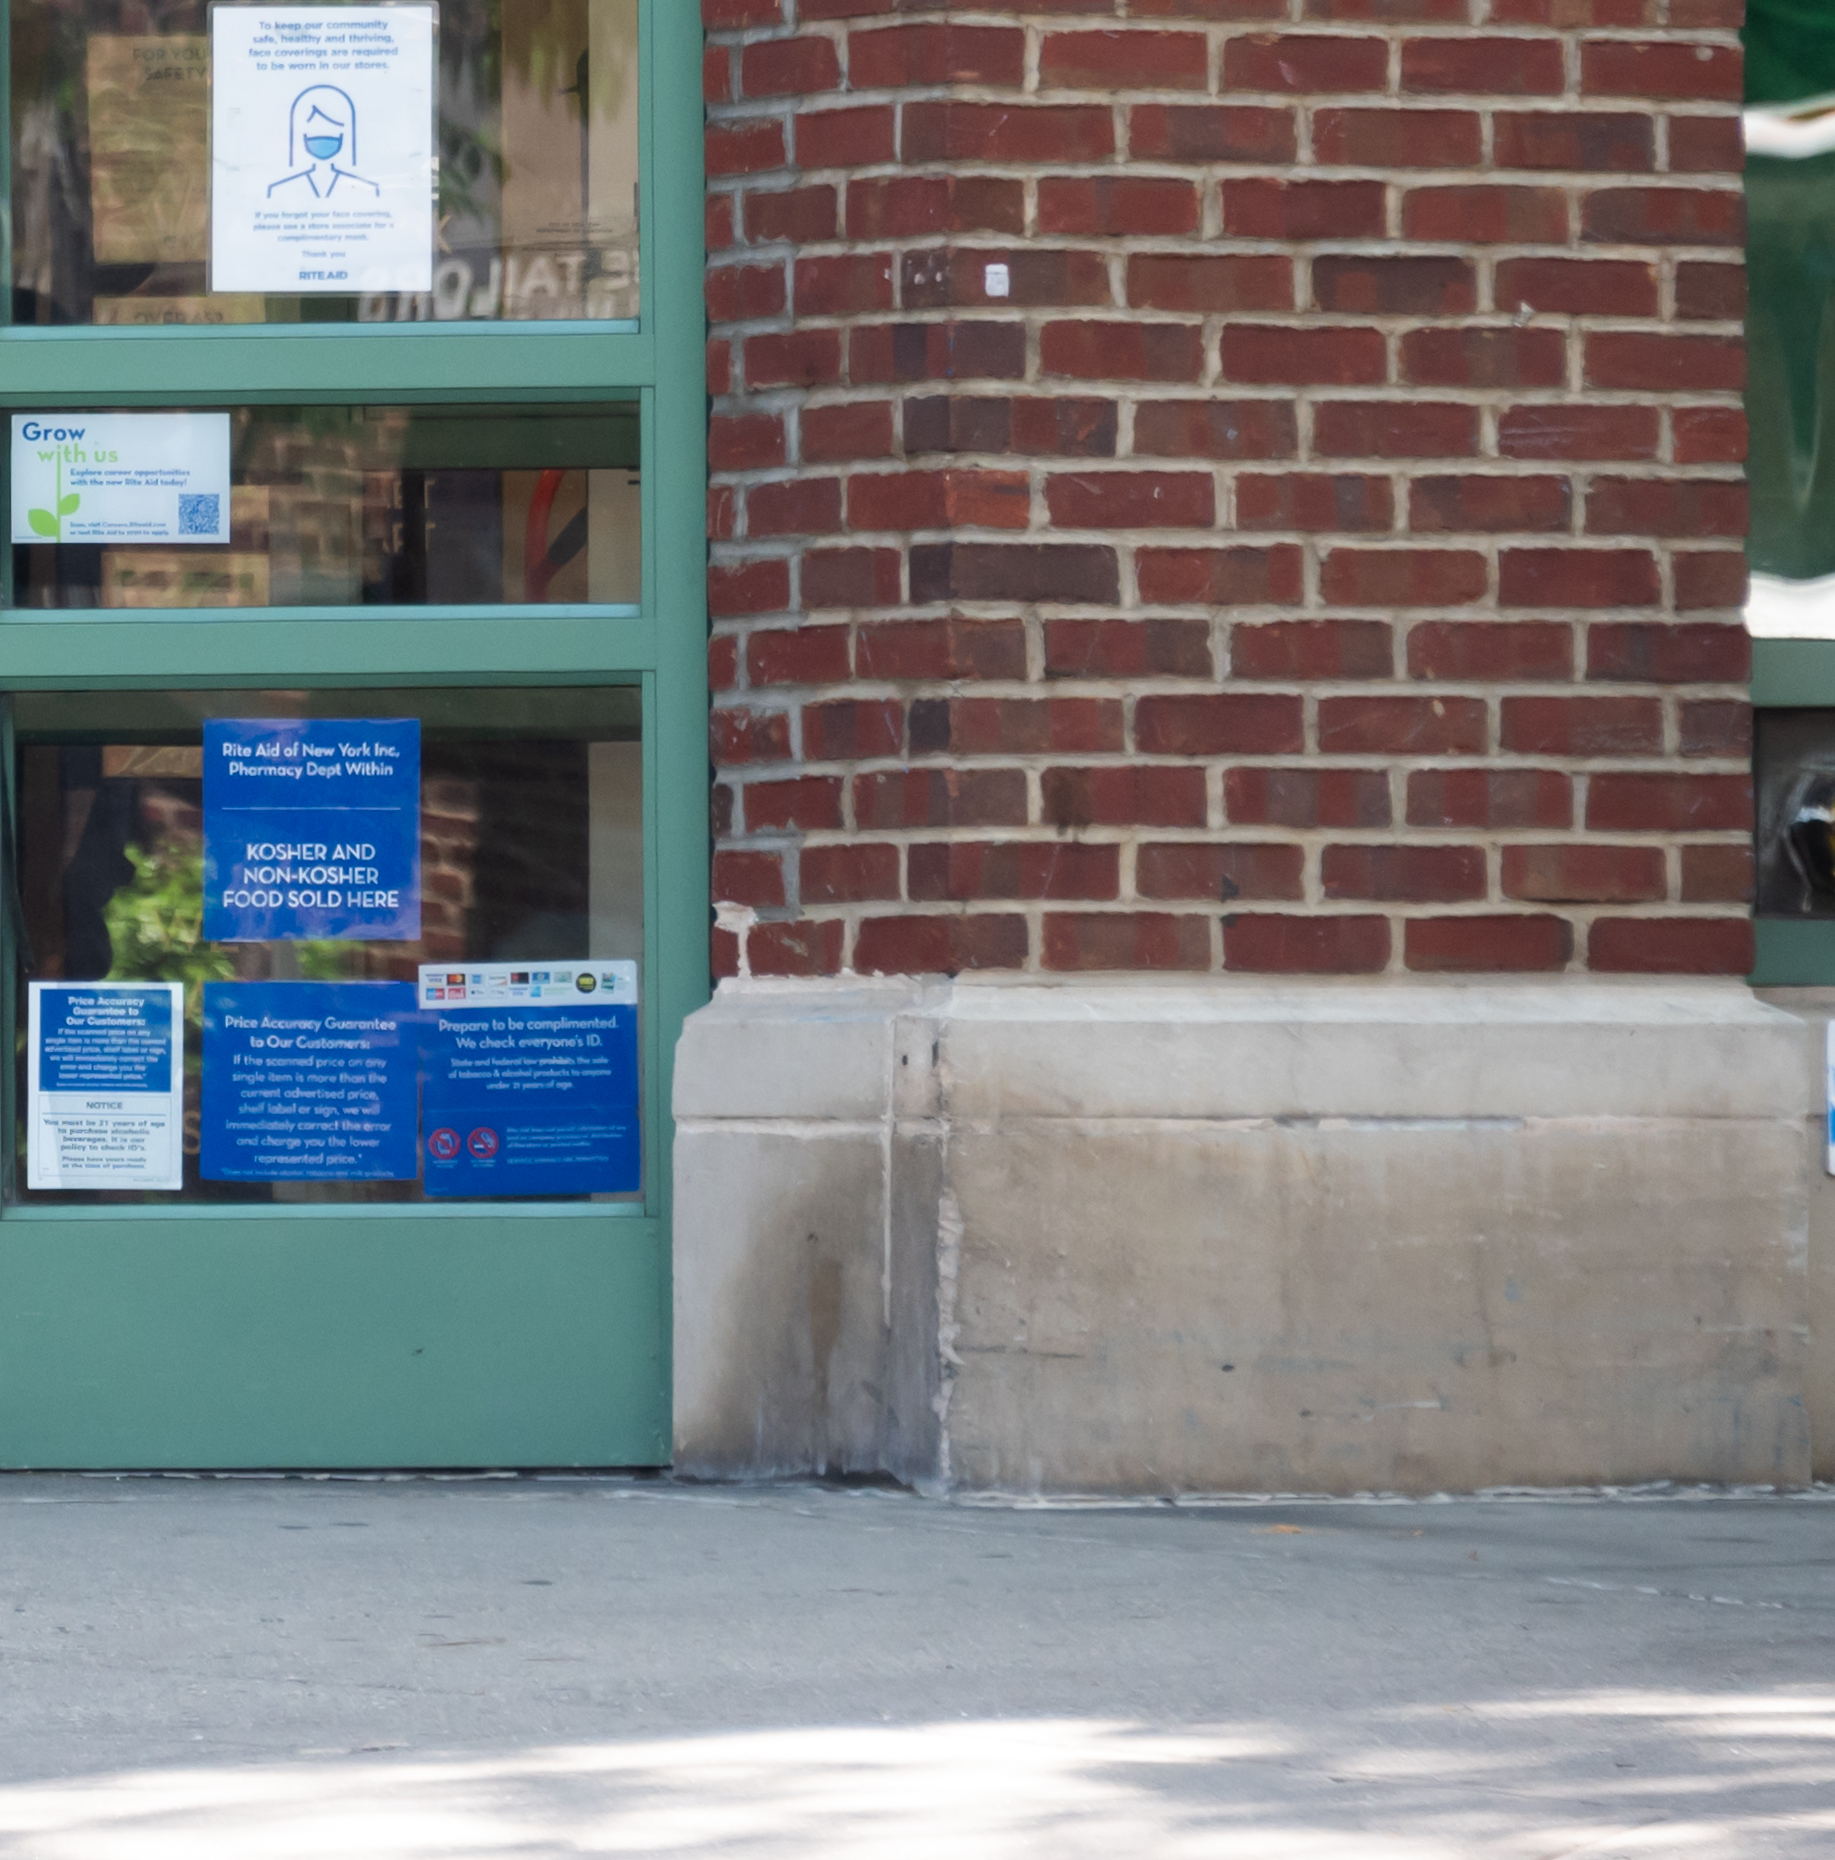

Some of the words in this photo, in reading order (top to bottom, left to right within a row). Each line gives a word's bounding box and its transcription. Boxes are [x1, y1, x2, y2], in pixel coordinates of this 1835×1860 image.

[259, 21, 271, 30] To
[275, 21, 301, 31] keep
[304, 22, 323, 30] our
[327, 20, 388, 31] community
[281, 33, 321, 45] healthy
[325, 34, 345, 43] and
[349, 33, 394, 43] thriving,
[170, 47, 208, 62] YOU
[249, 48, 271, 57] face
[275, 47, 328, 58] coverings
[331, 49, 348, 57] are
[352, 47, 399, 58] required
[256, 62, 267, 71] to
[271, 61, 284, 71] be
[288, 63, 316, 71] worn
[319, 61, 329, 70] in
[354, 61, 390, 70] stores.
[299, 271, 325, 281] RITE
[326, 271, 349, 280] AID
[22, 421, 86, 442] Grow
[37, 443, 86, 463] with
[94, 449, 118, 463] us
[222, 742, 252, 757] Rite
[255, 742, 280, 758] Aid
[283, 741, 299, 757] of
[302, 742, 336, 758] New
[338, 742, 371, 758] York
[229, 761, 304, 780] Pharmacy
[306, 761, 342, 779] Dept
[344, 760, 393, 777] Within
[246, 842, 327, 861] KOSHER
[331, 843, 376, 861] AND
[243, 866, 380, 885] NON-KOSHER
[222, 890, 284, 908] FOOD
[287, 890, 343, 908] SOLD
[347, 890, 400, 908] HERE
[224, 1015, 258, 1029] Price
[260, 1016, 322, 1033] Accuracy
[324, 1016, 397, 1031] Guarantee
[438, 1018, 489, 1034] Prepare
[492, 1018, 506, 1031] to
[508, 1016, 525, 1031] be
[527, 1015, 619, 1033] complimented.
[250, 1035, 264, 1049] to
[266, 1035, 293, 1049] Our
[295, 1035, 371, 1050] Customers:
[456, 1037, 477, 1050] We
[479, 1034, 515, 1050] check
[518, 1034, 584, 1051] everyone's
[586, 1034, 603, 1048] ID.
[232, 1070, 265, 1085] single
[267, 1071, 293, 1083] item
[295, 1071, 305, 1083] is
[306, 1073, 337, 1083] more
[339, 1071, 366, 1084] than
[368, 1071, 388, 1084] the
[85, 1101, 124, 1111] NOTICE
